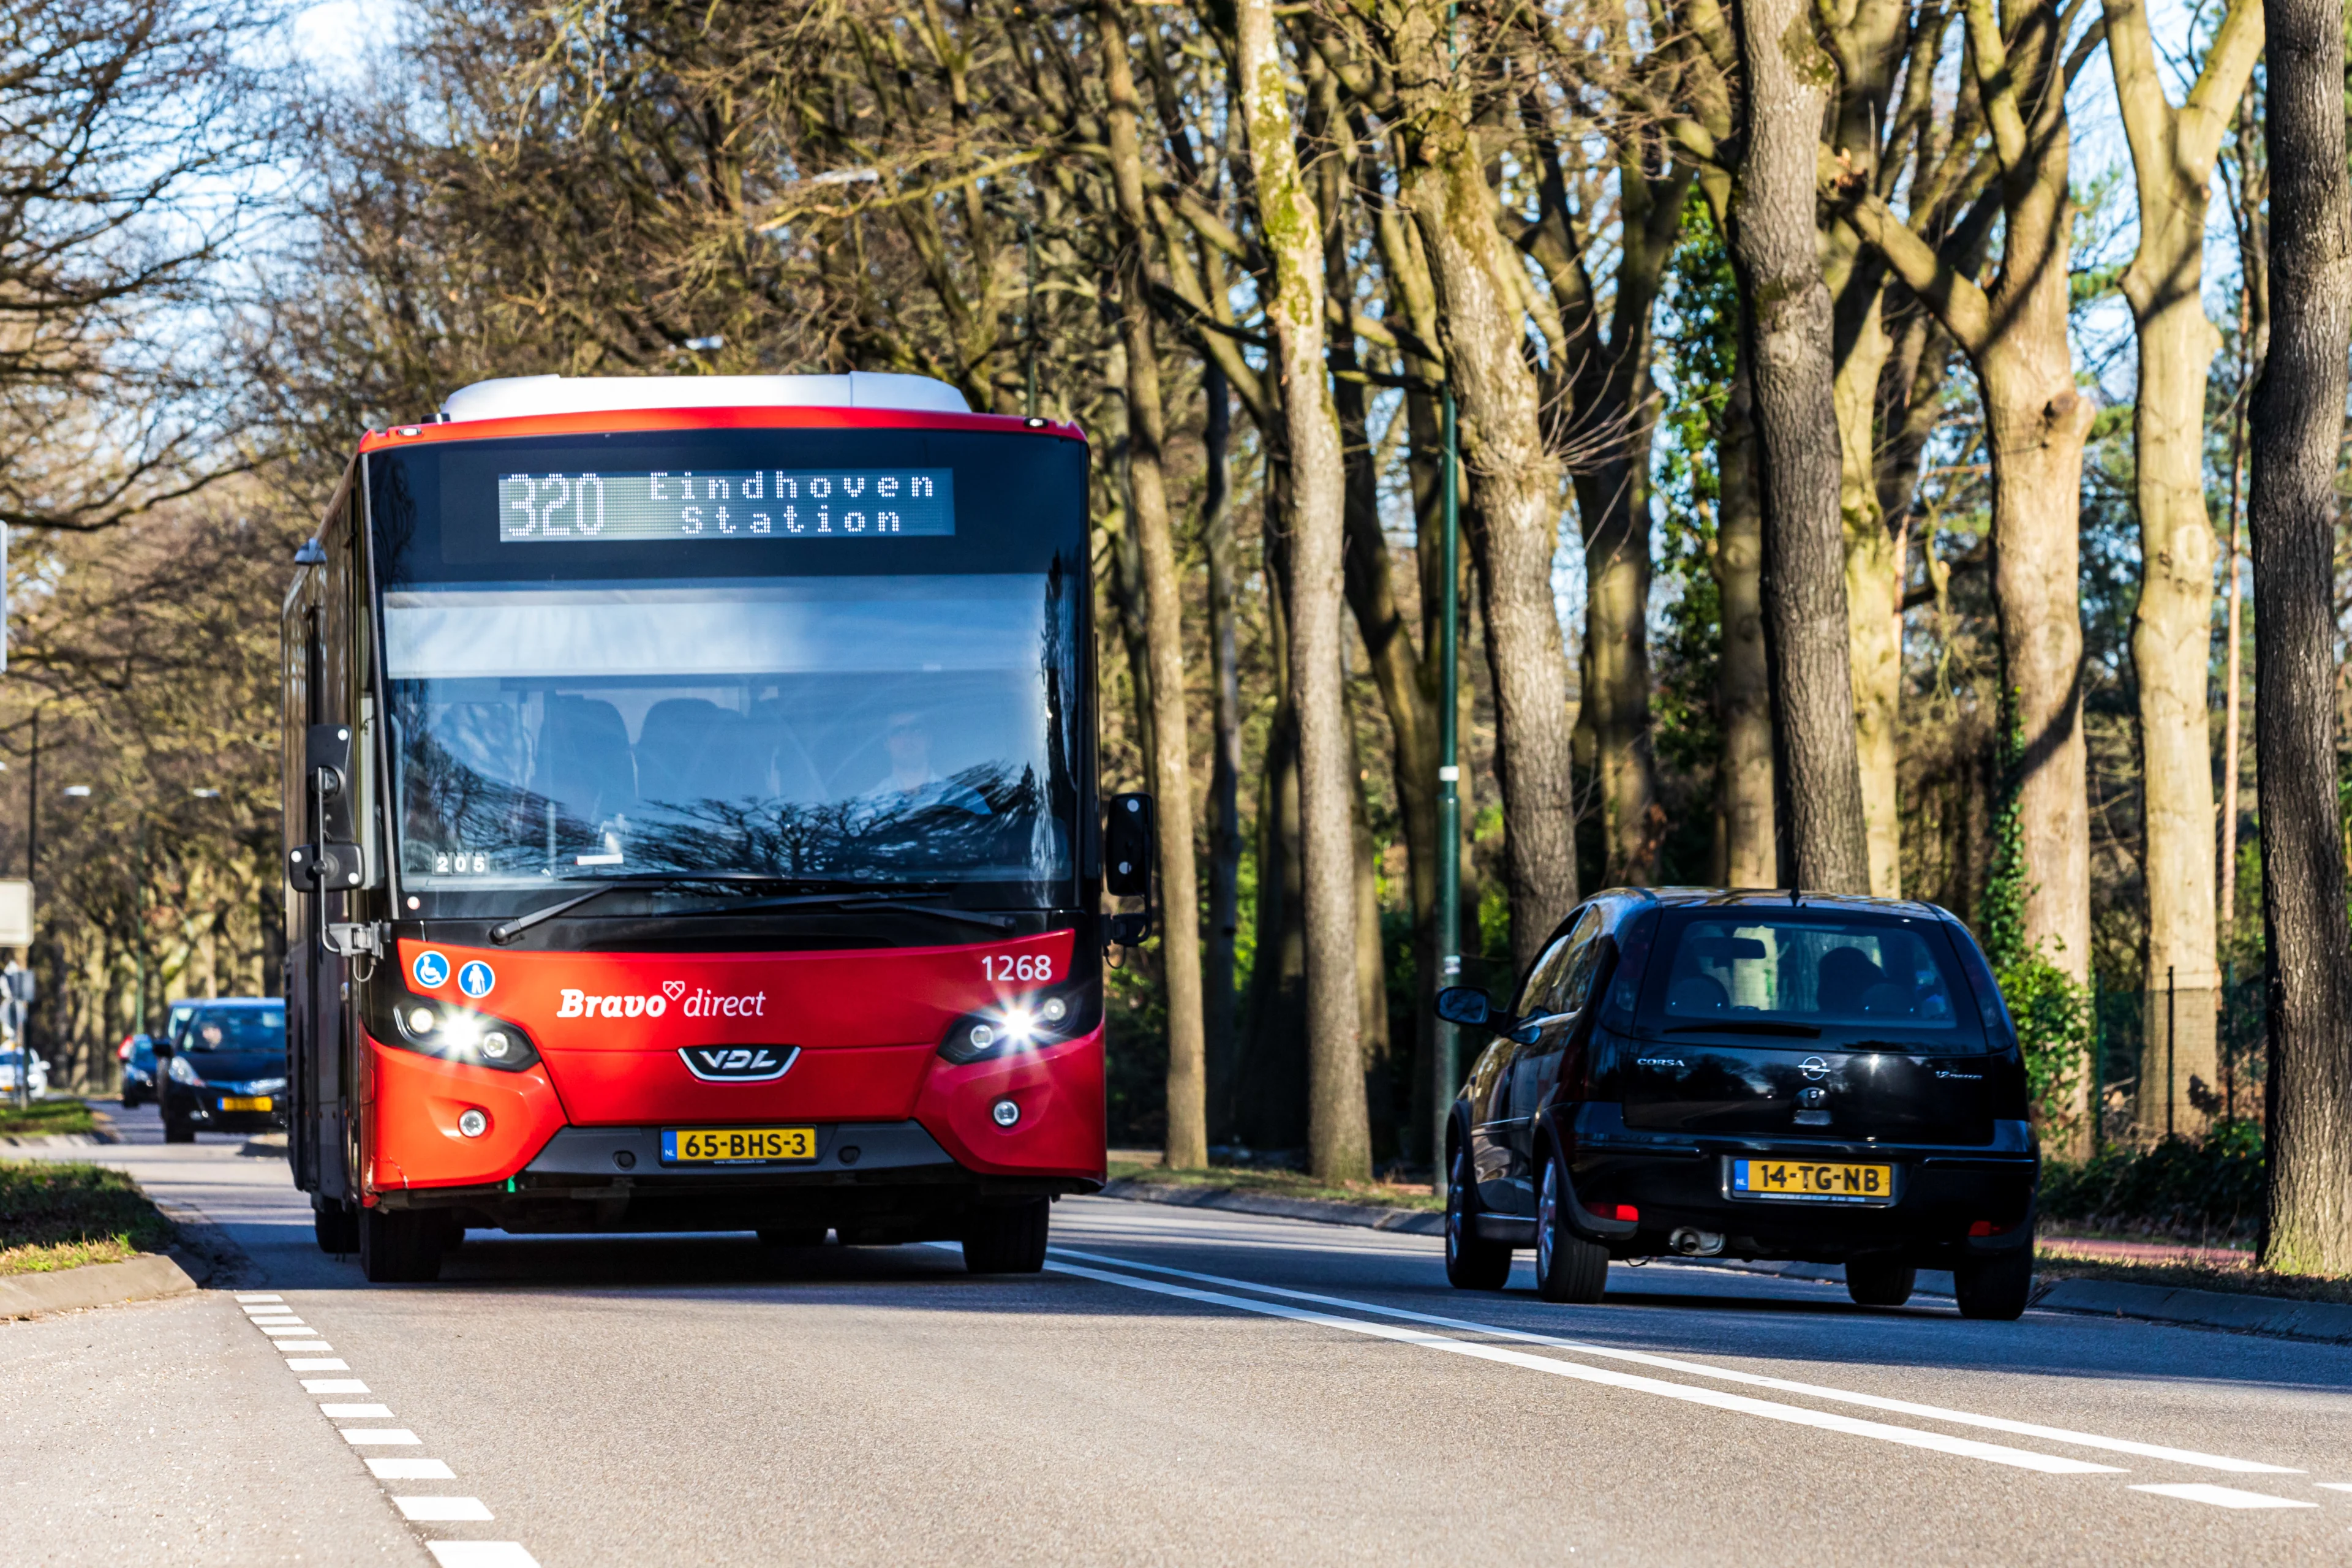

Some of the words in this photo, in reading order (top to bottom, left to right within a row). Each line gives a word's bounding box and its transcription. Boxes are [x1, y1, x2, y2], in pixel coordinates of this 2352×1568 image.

[650, 470, 933, 500] Eindhoven
[508, 473, 605, 537] 320
[682, 505, 900, 535] Station
[437, 856, 485, 872] 205
[982, 955, 1052, 981] 1268
[556, 989, 666, 1018] Bravo
[684, 988, 766, 1017] direct
[698, 1050, 777, 1069] VDL
[1637, 1058, 1685, 1067] CORSA
[685, 1133, 807, 1157] 65-BHS-3
[1761, 1164, 1880, 1192] 14-TG-NB
